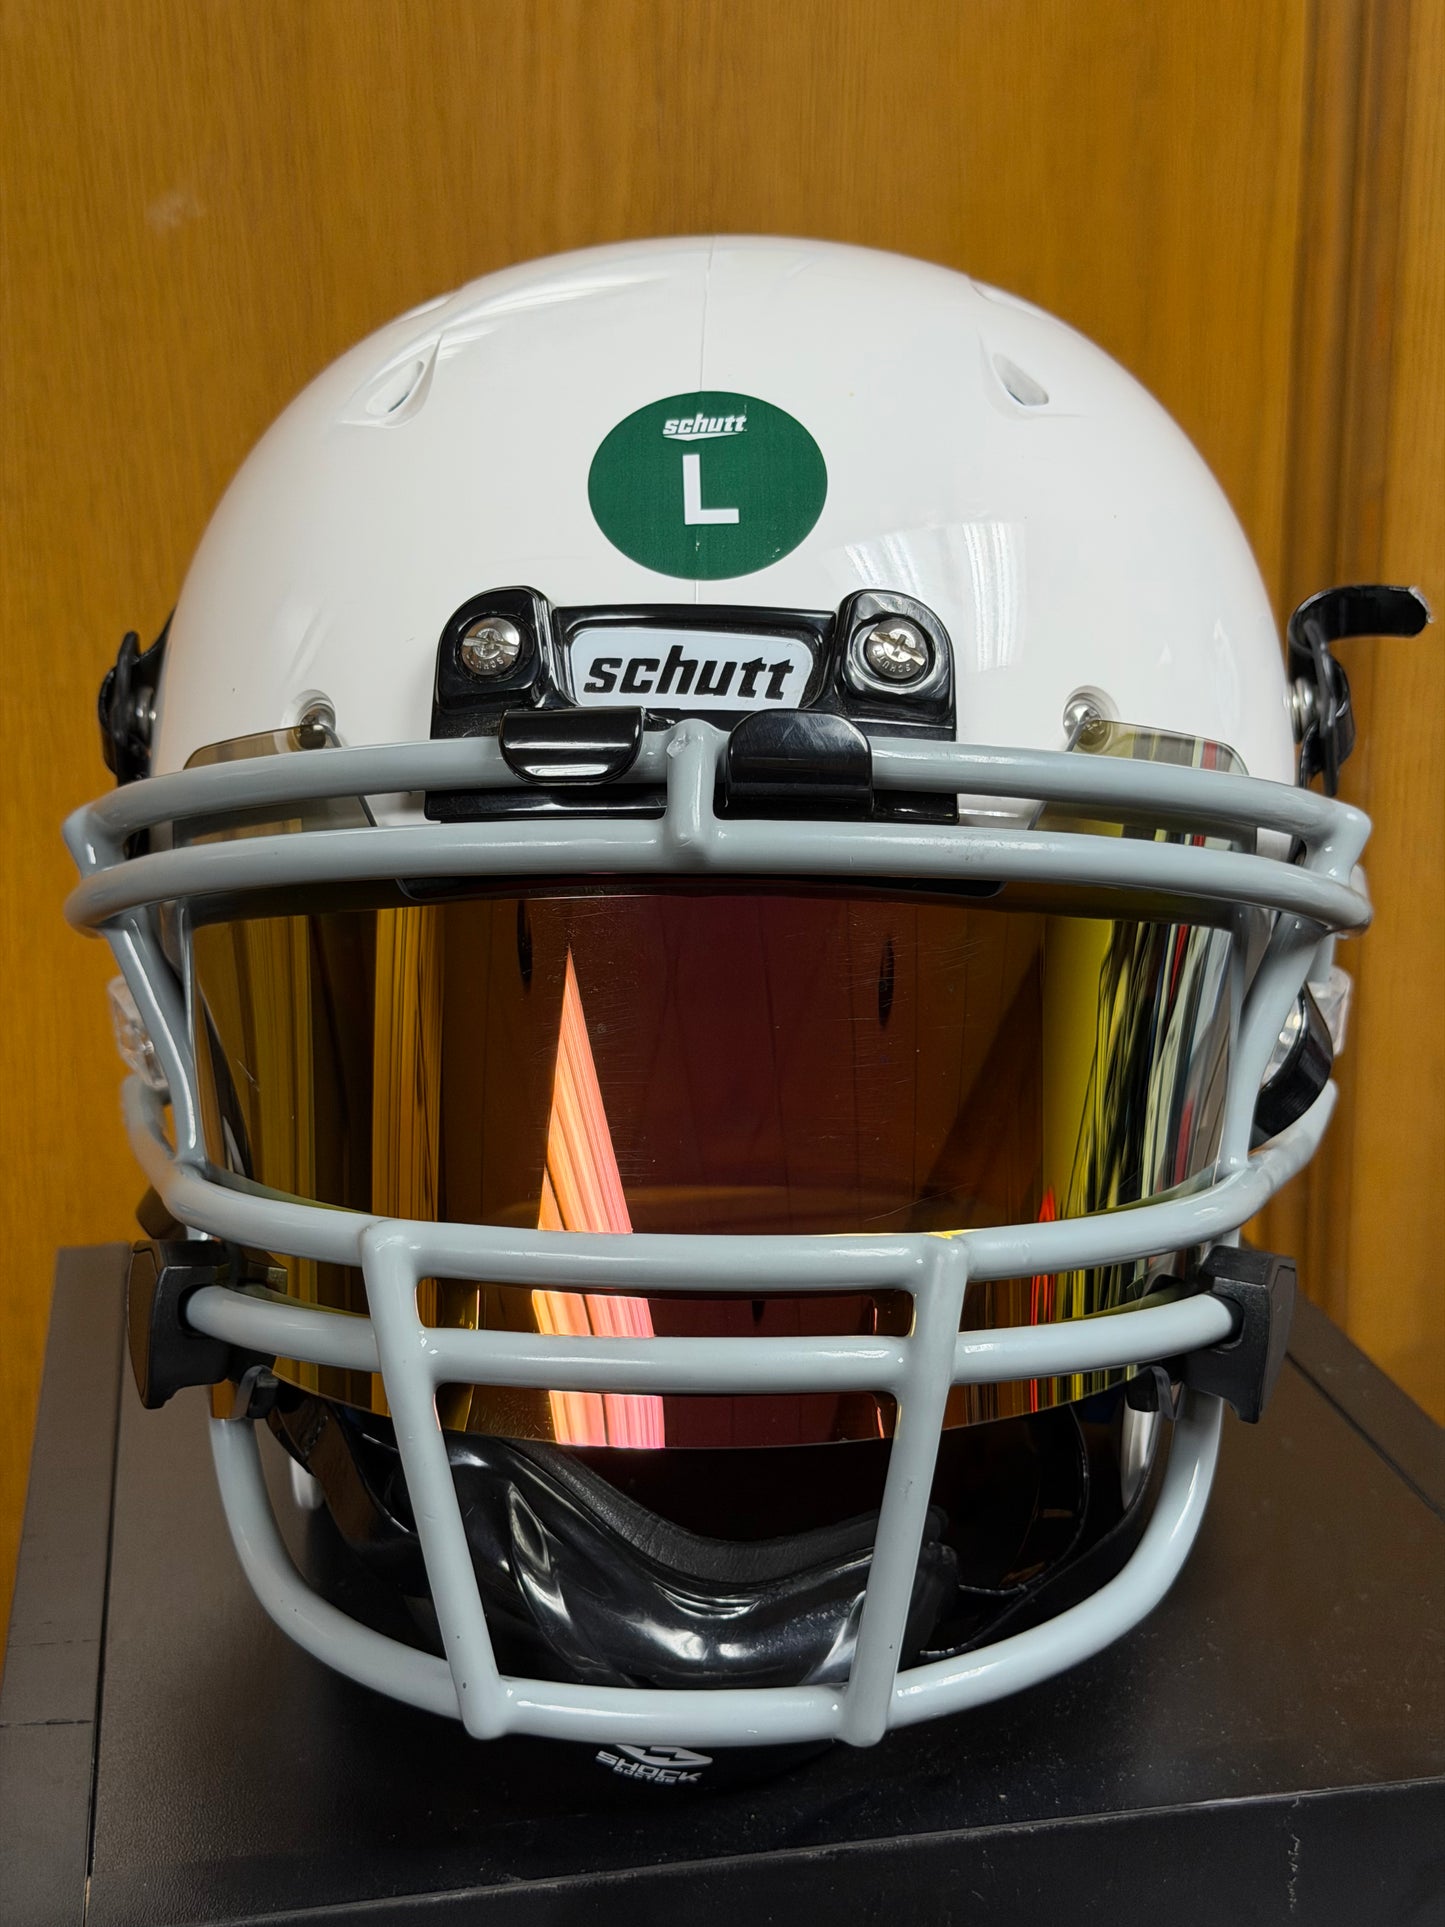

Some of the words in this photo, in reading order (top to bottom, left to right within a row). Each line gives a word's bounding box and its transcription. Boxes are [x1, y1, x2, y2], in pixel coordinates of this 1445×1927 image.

[662, 413, 747, 436] schutt
[682, 453, 740, 526] L
[583, 644, 795, 700] schutt
[595, 1750, 703, 1782] SHOCK
